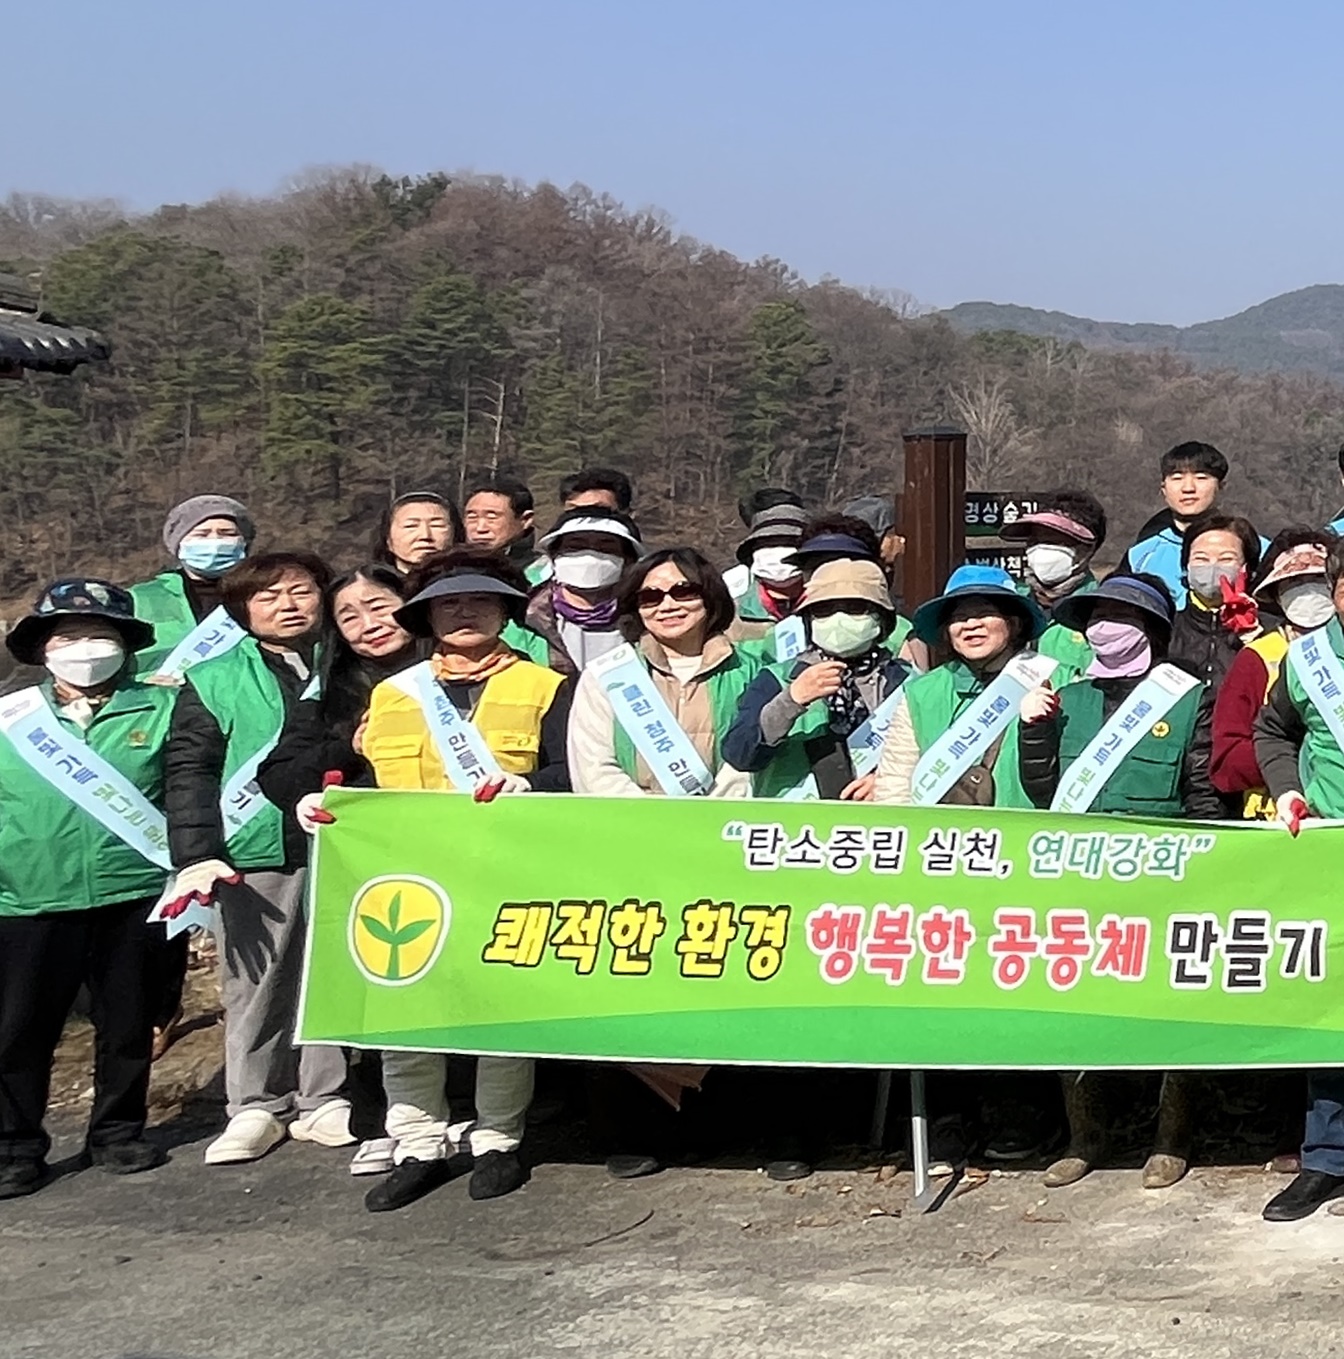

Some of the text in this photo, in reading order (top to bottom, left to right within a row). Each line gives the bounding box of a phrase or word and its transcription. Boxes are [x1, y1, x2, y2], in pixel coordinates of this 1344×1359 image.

[922, 832, 1010, 874] 실천,
[482, 899, 1323, 988] 쾌적한 환경 행복한 공동체 만들기
